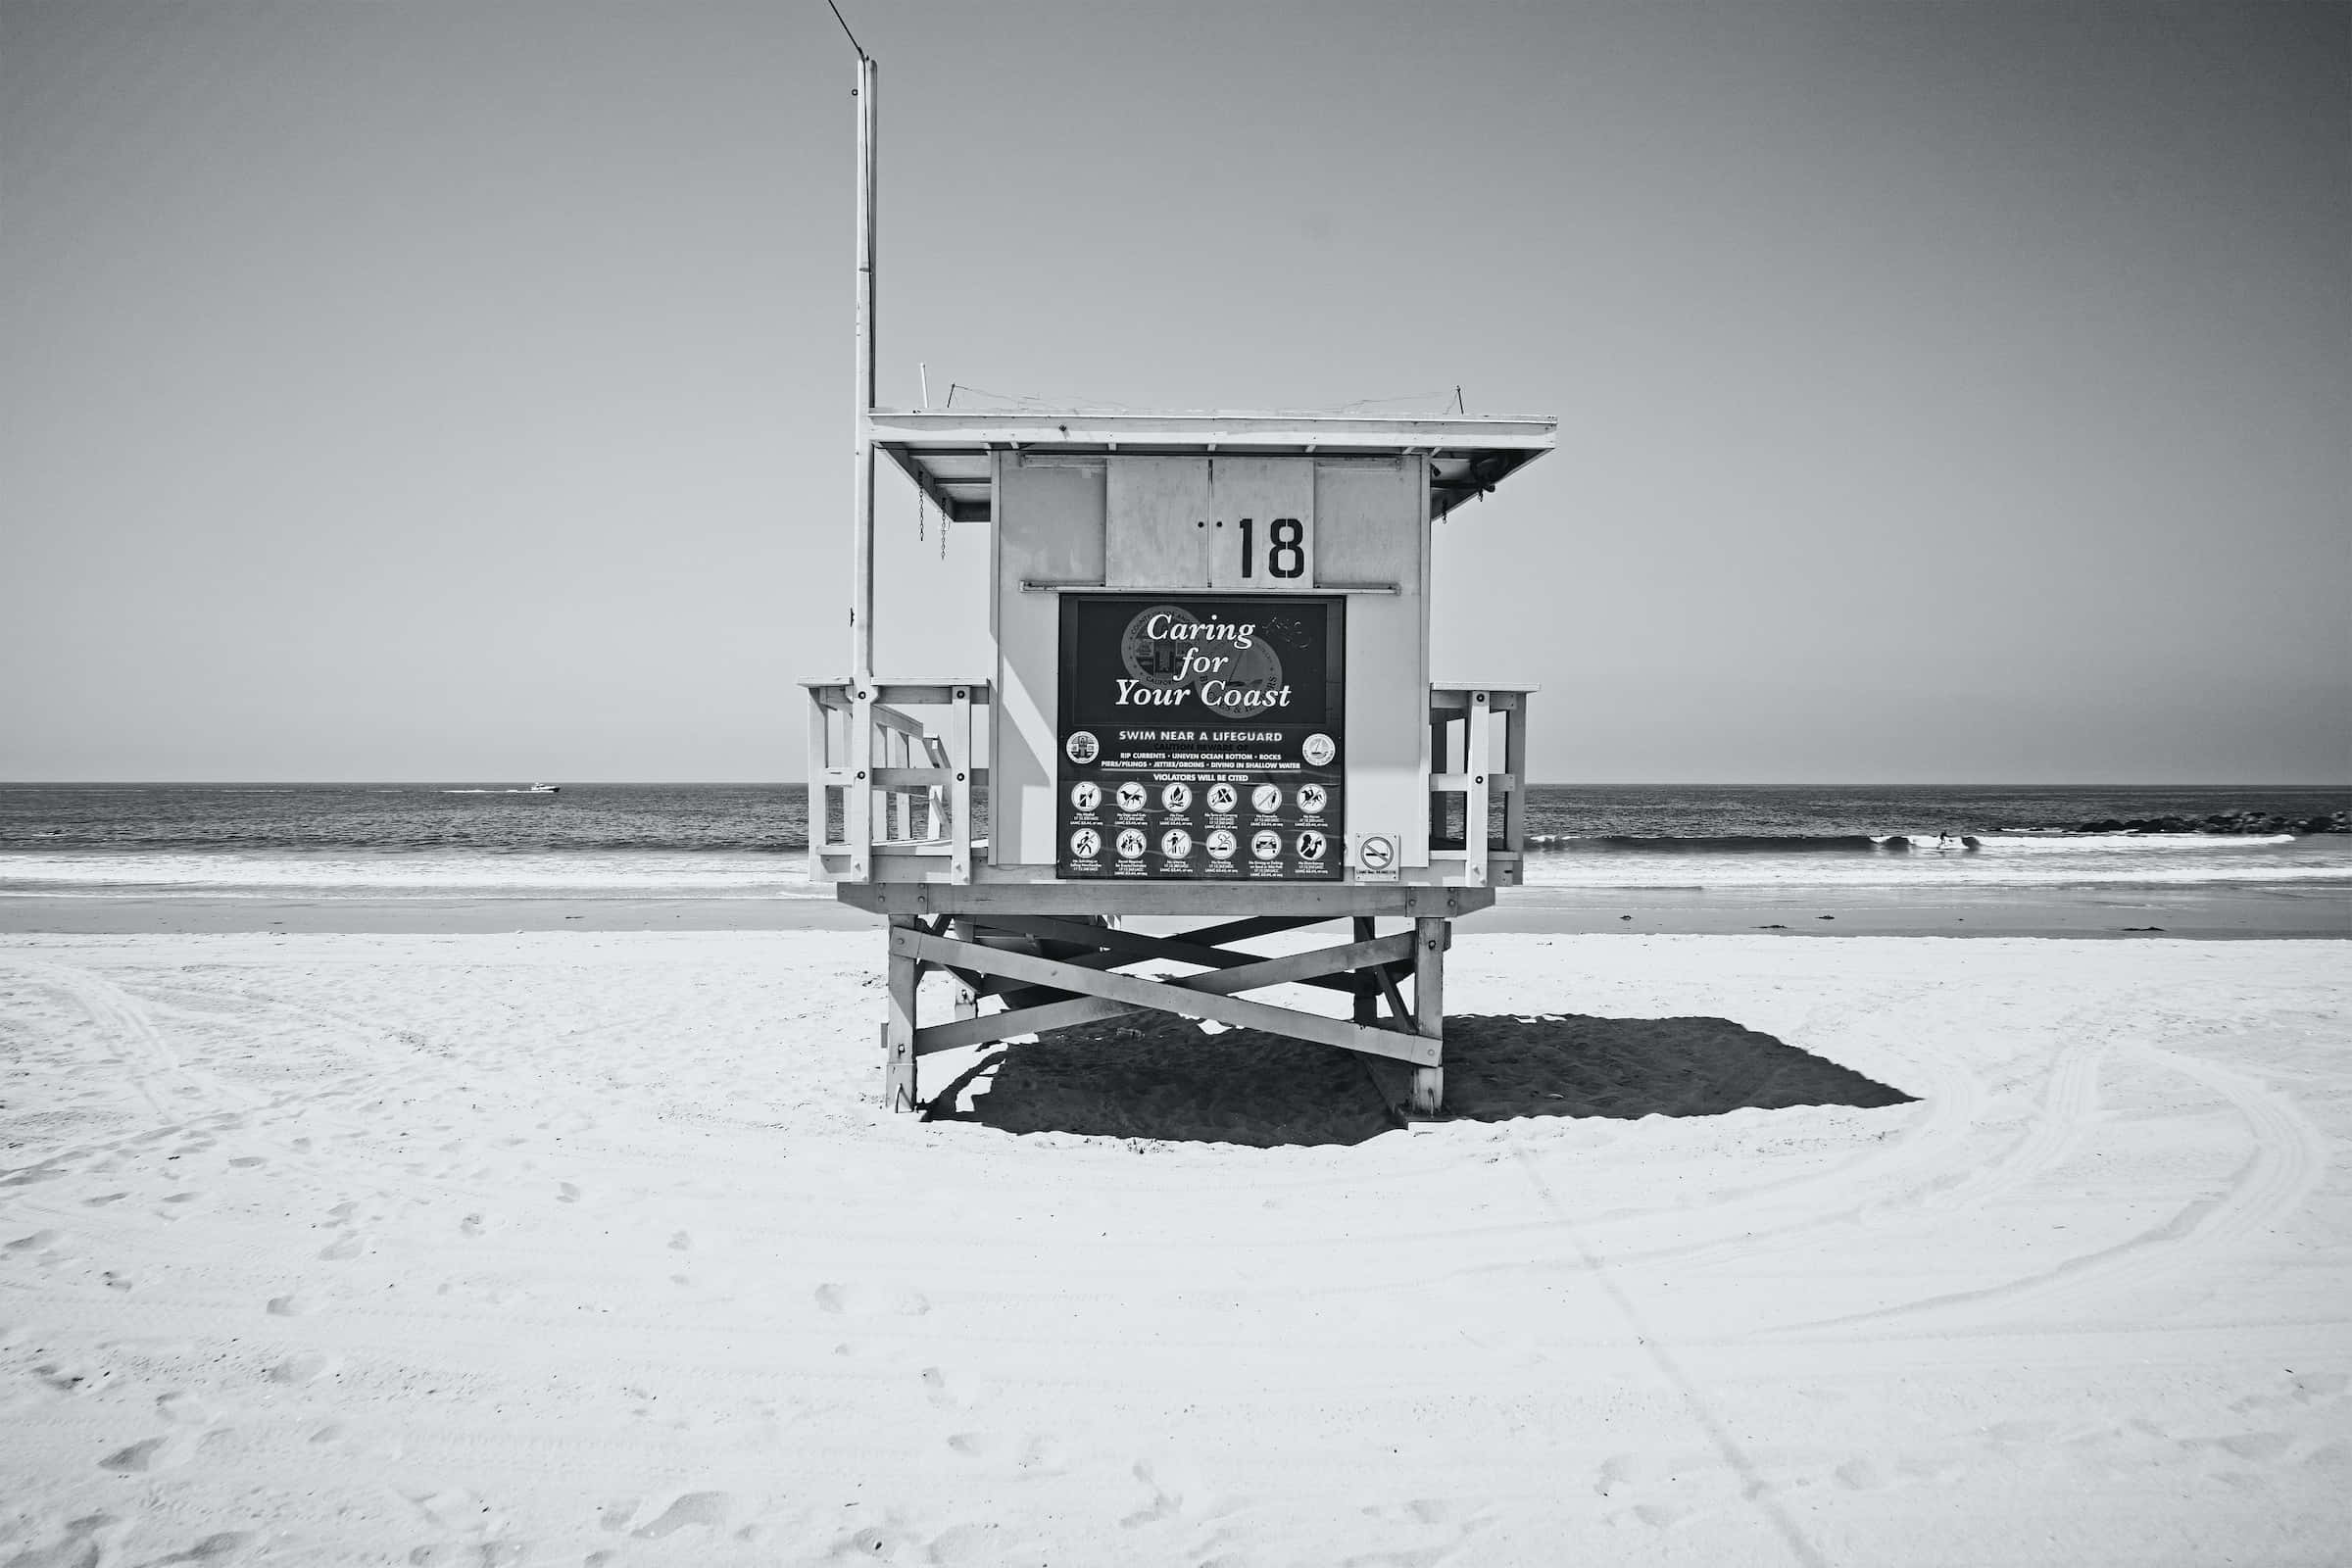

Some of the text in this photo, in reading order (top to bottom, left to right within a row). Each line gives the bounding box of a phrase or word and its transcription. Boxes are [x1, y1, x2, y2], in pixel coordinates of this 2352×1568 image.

[1240, 518, 1304, 578] 18
[1147, 613, 1255, 649] Caring
[1173, 647, 1229, 681] for
[1115, 679, 1292, 707] Your Coast
[1119, 731, 1283, 742] SWIM NEAR A LIFEGUARD
